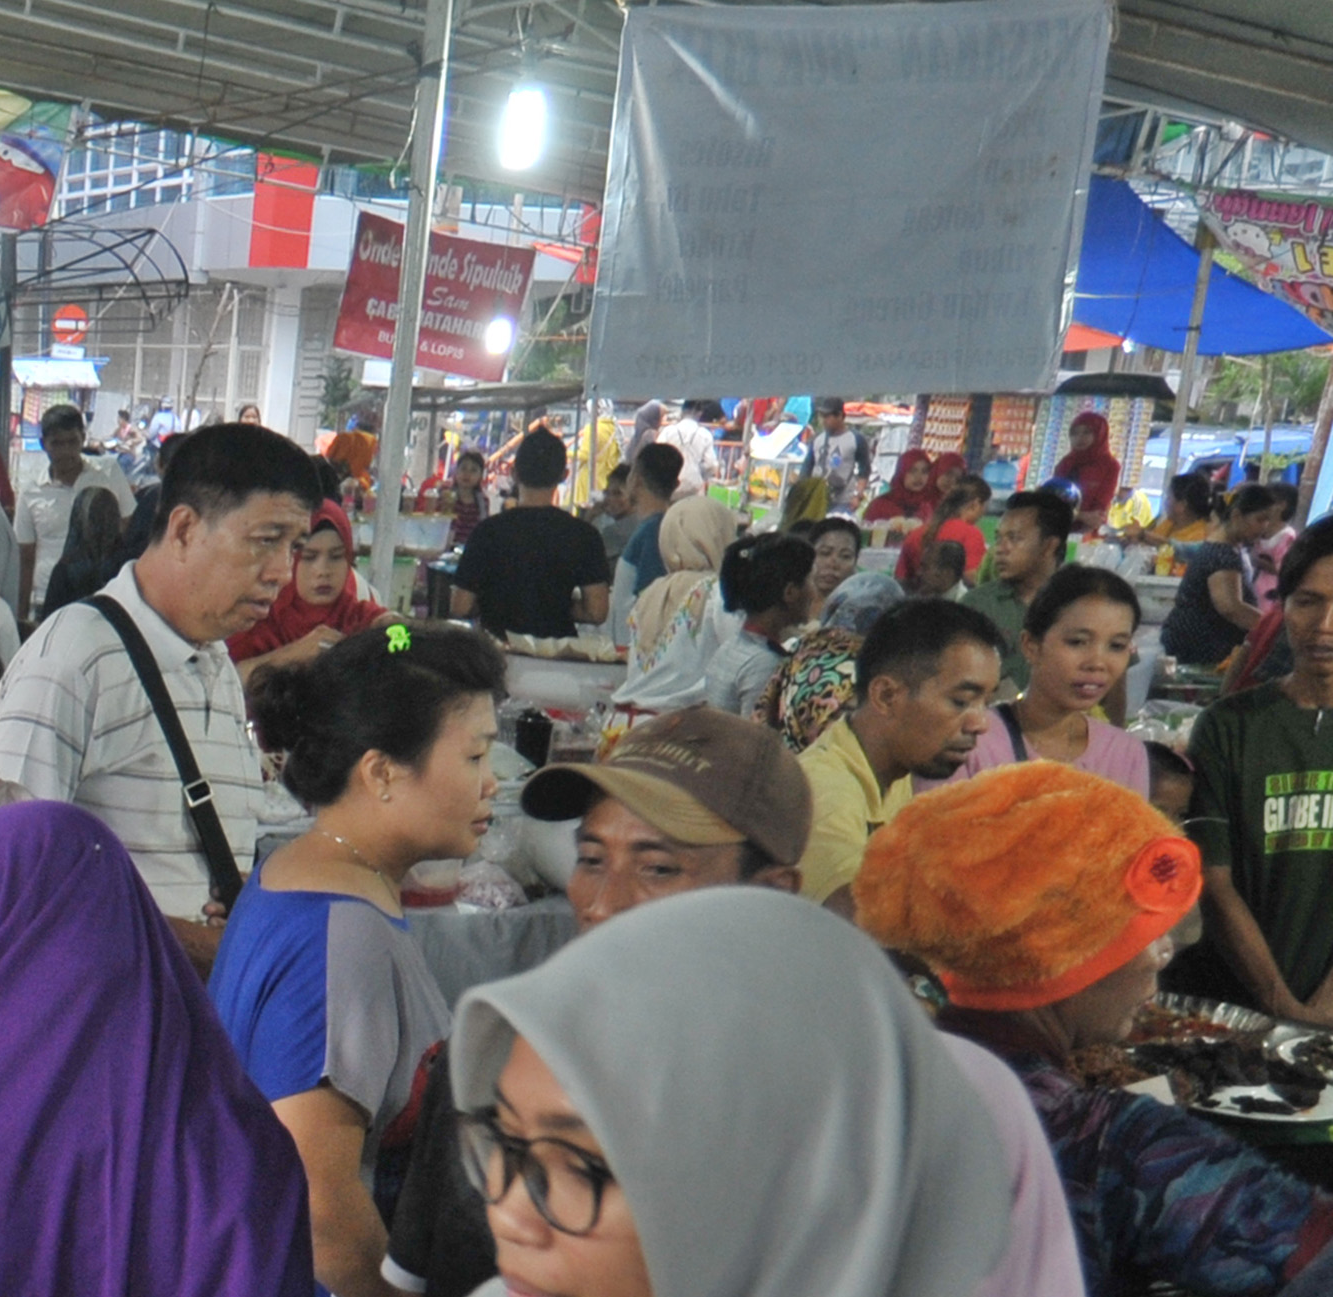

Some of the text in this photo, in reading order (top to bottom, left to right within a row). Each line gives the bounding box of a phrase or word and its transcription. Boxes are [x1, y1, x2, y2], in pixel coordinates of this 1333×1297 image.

[359, 228, 400, 267] Onde
[426, 246, 458, 282] nde
[1264, 794, 1321, 834] GLOBE
